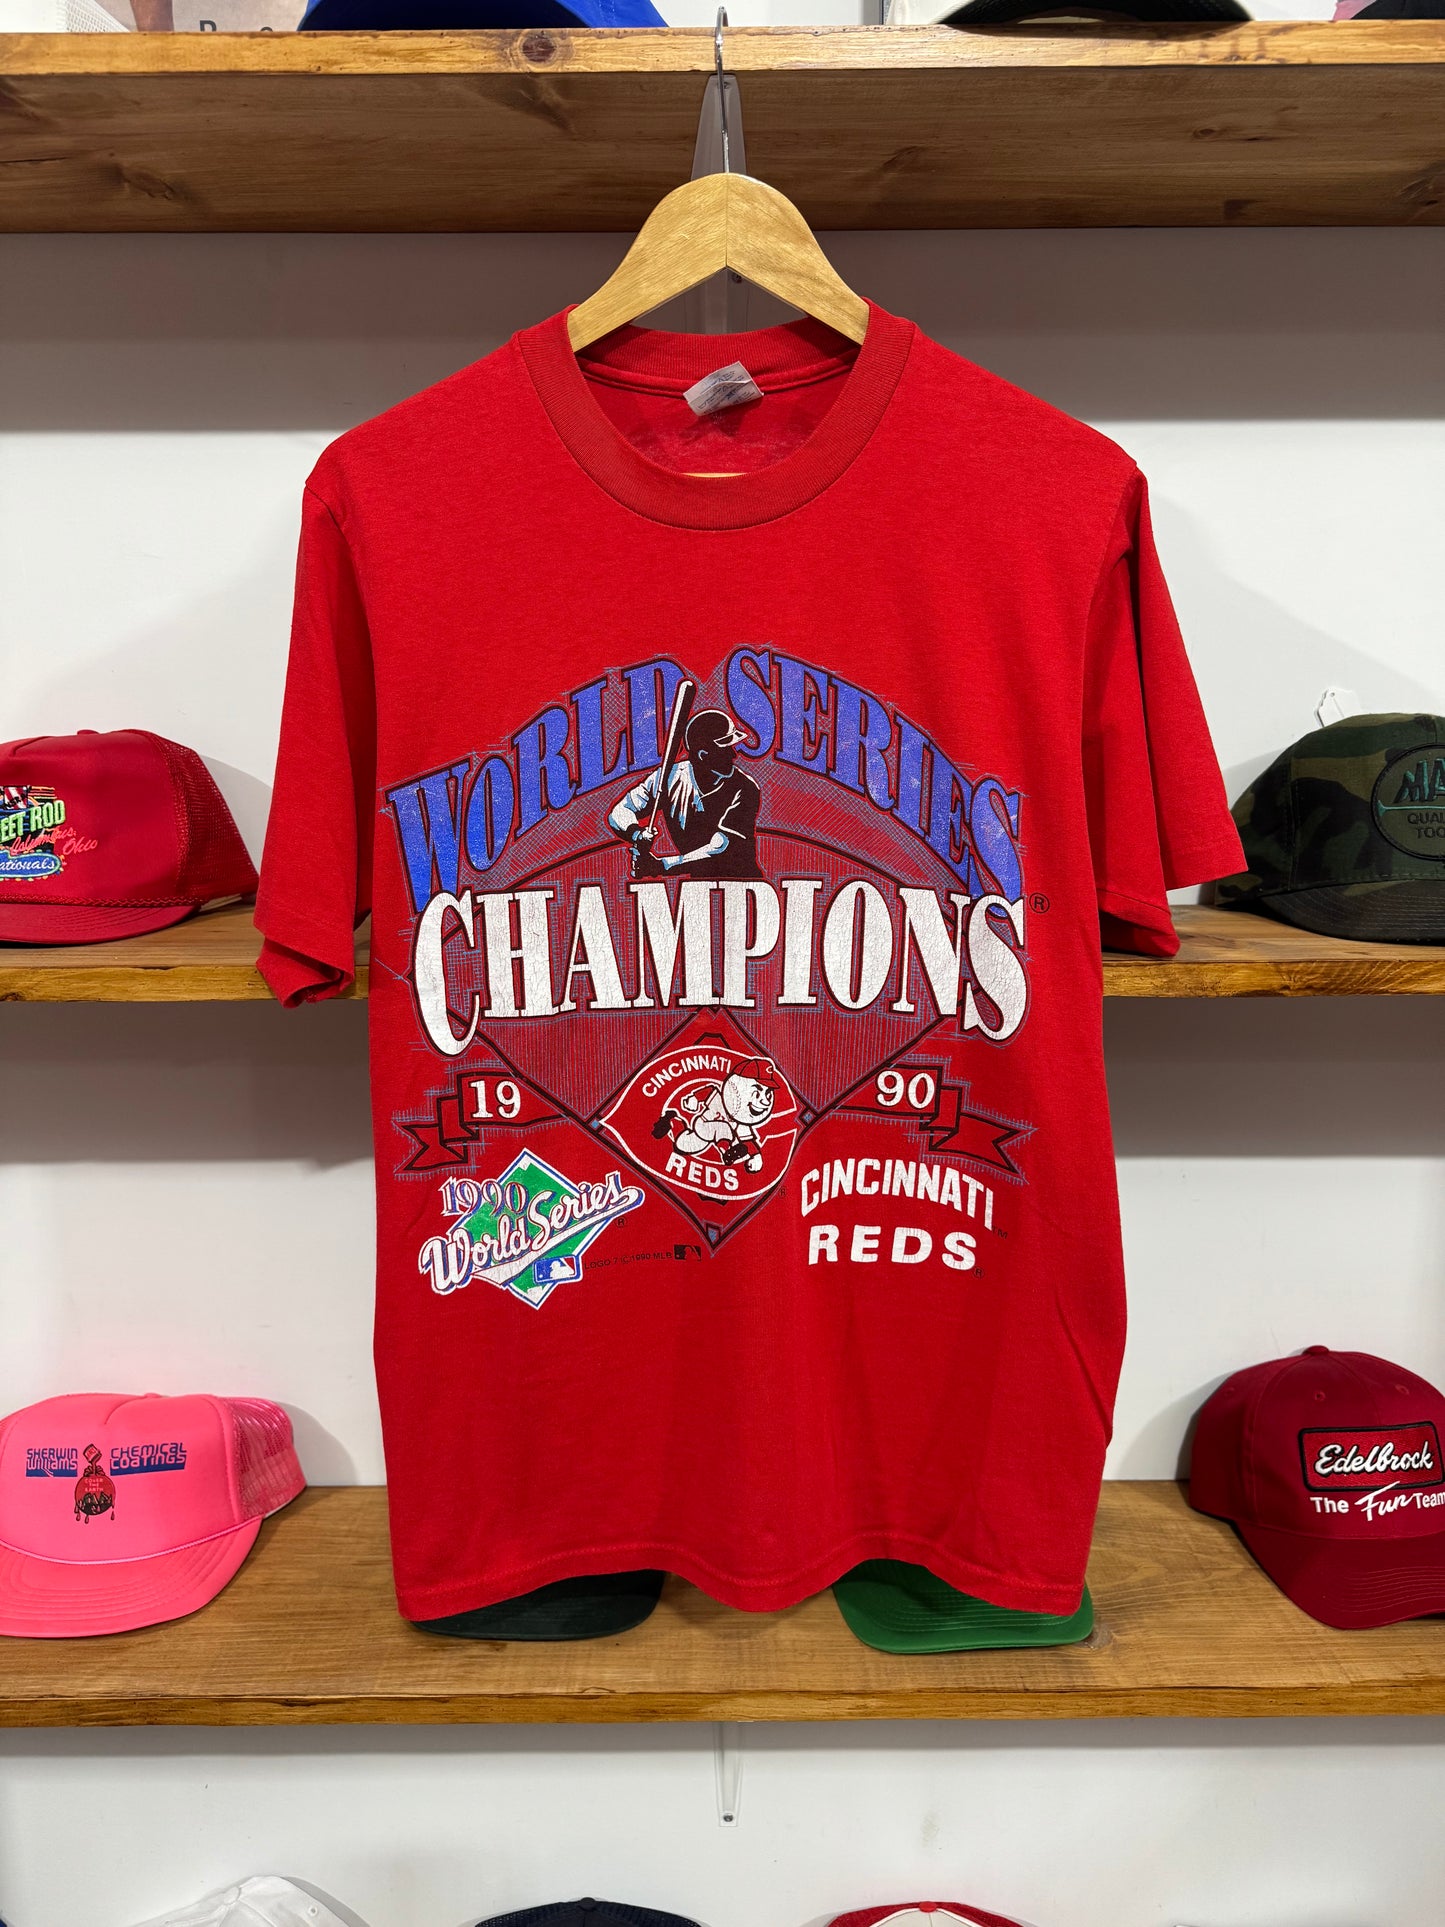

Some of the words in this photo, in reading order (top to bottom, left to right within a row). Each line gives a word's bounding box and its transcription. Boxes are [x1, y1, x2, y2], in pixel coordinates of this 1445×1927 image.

[387, 660, 686, 911] WORLD
[724, 648, 1022, 917] SERIES
[30, 800, 66, 832] ROD
[62, 836, 98, 855] Ohio
[414, 879, 1028, 1057] CHAMPIONS
[642, 1055, 731, 1097] CINCINNATI
[877, 1070, 935, 1109] 90
[470, 1080, 521, 1118] 19
[665, 1153, 739, 1191] REDS
[438, 1177, 529, 1216] 1990
[801, 1158, 994, 1231] CINCINNATI
[419, 1214, 530, 1294] World
[528, 1171, 643, 1252] Series
[808, 1224, 977, 1271] REDS
[26, 1447, 78, 1459] SHERWIN
[1315, 1440, 1434, 1475] Edelbrock
[1310, 1497, 1349, 1513] The
[1354, 1481, 1414, 1521] Fun
